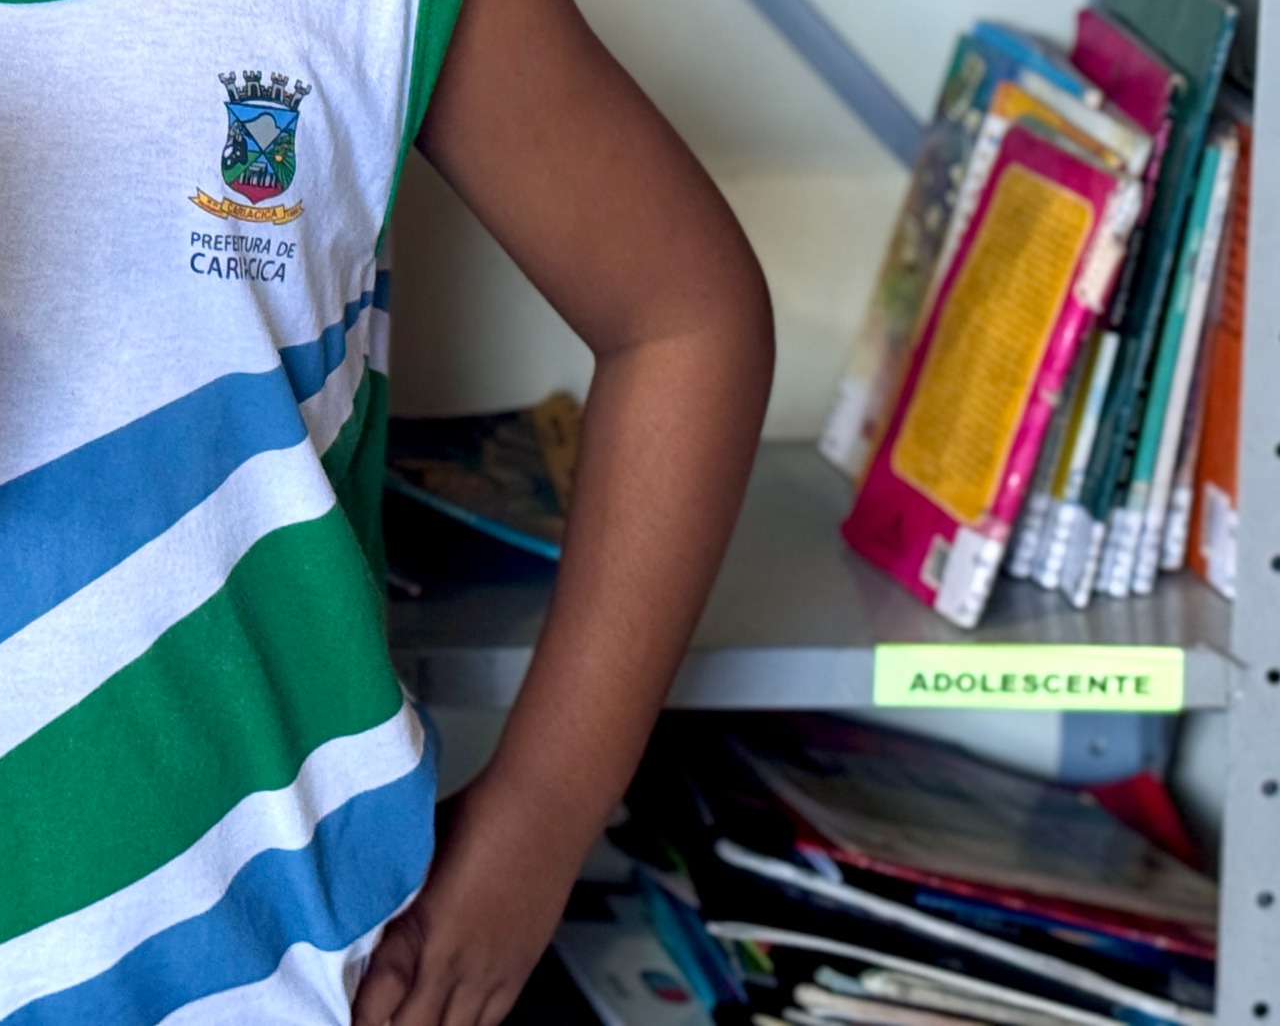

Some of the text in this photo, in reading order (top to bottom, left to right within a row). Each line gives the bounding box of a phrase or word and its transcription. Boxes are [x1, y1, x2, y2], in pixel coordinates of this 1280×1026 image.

[190, 231, 297, 260] PREFEITURA DE
[909, 672, 1152, 696] ADOLESCENTE
